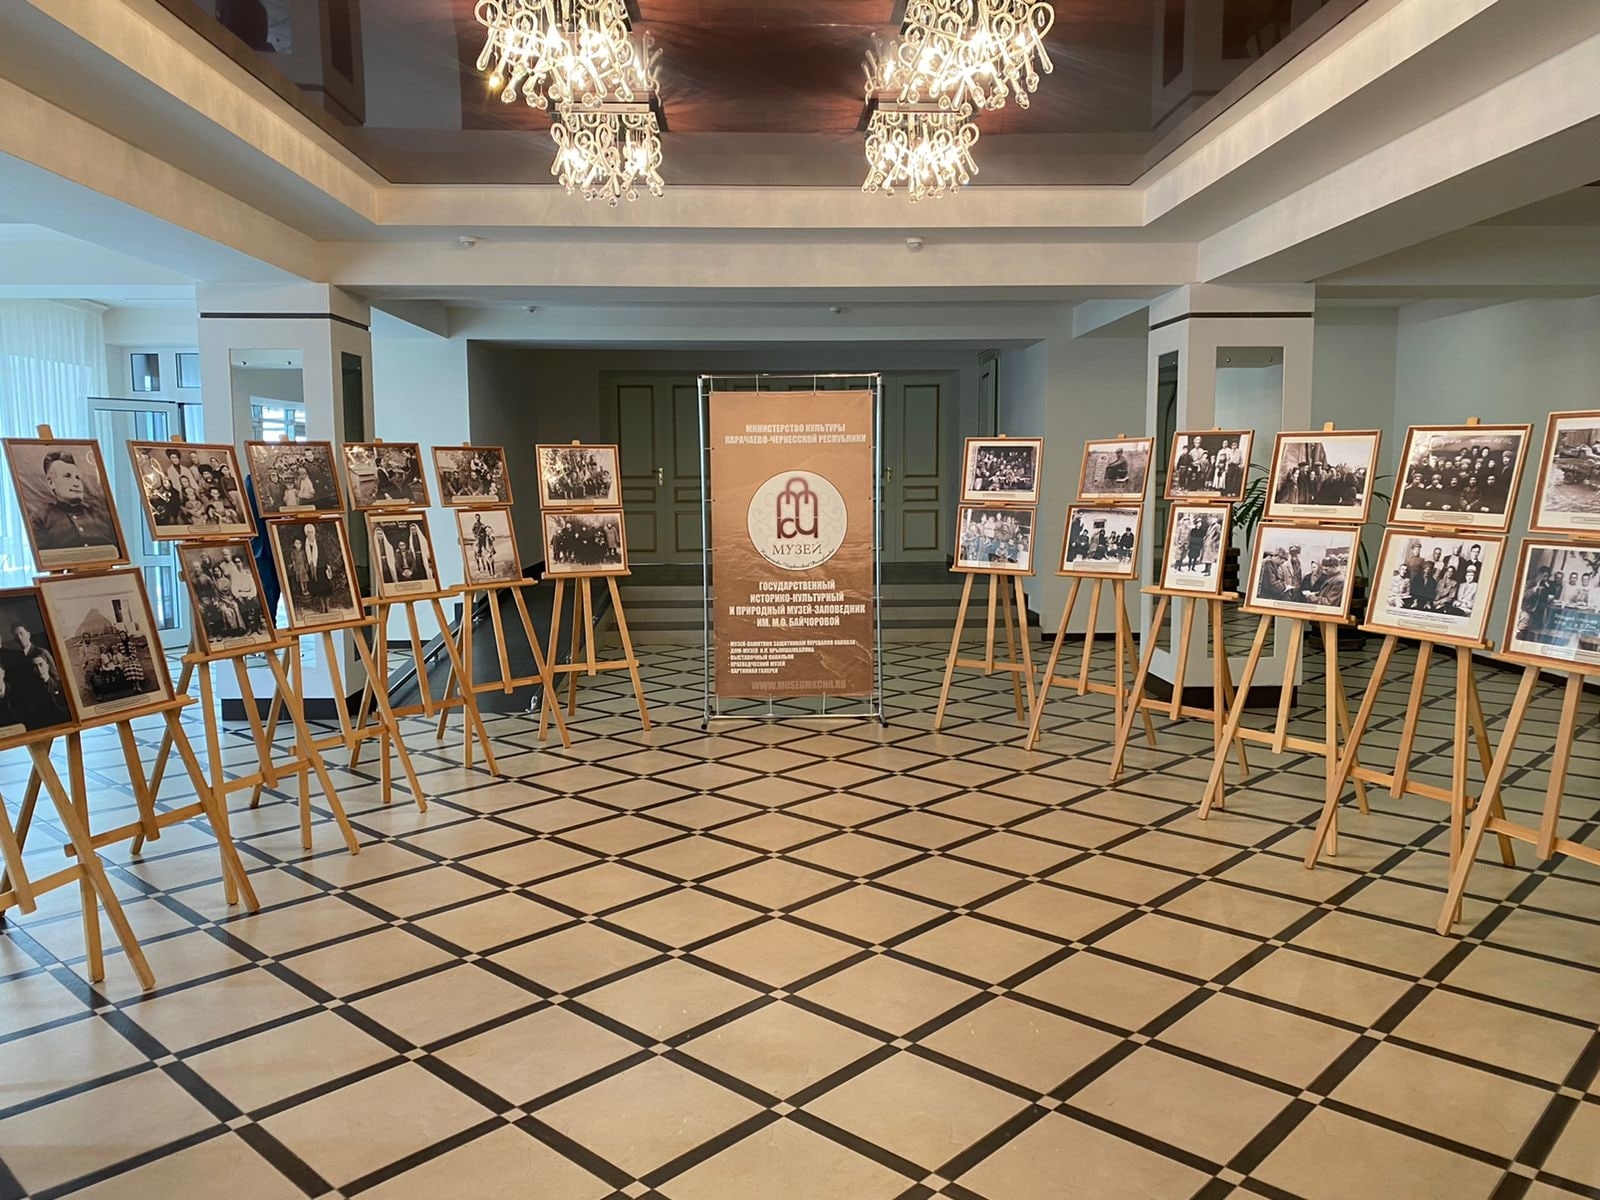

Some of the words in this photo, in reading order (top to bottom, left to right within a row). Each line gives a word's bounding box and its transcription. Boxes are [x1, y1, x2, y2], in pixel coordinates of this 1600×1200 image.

[745, 424, 804, 432] МИНИСТЕРСТВО
[806, 423, 846, 432] КУЛЬТУРЫ
[724, 434, 817, 444] КАРАЧАЕВО-ЧЕРКЕССКОЙ
[818, 434, 866, 443] РЕСПУБЛИКИ
[772, 542, 823, 555] МУЗЕЙ
[759, 579, 836, 592] ГОСУДАРСТВЕННЫЙ
[750, 592, 844, 603] ИСТОРИКО-КУЛЬТУРНЫЙ
[729, 606, 735, 615] И
[736, 604, 786, 616] ПРИРОДНЫЙ
[786, 604, 866, 615] МУЗЕЙ-ЗАПОВЕДНИК
[756, 618, 770, 628] ИМ.
[789, 616, 840, 627] БАЙЧОРОВОЙ
